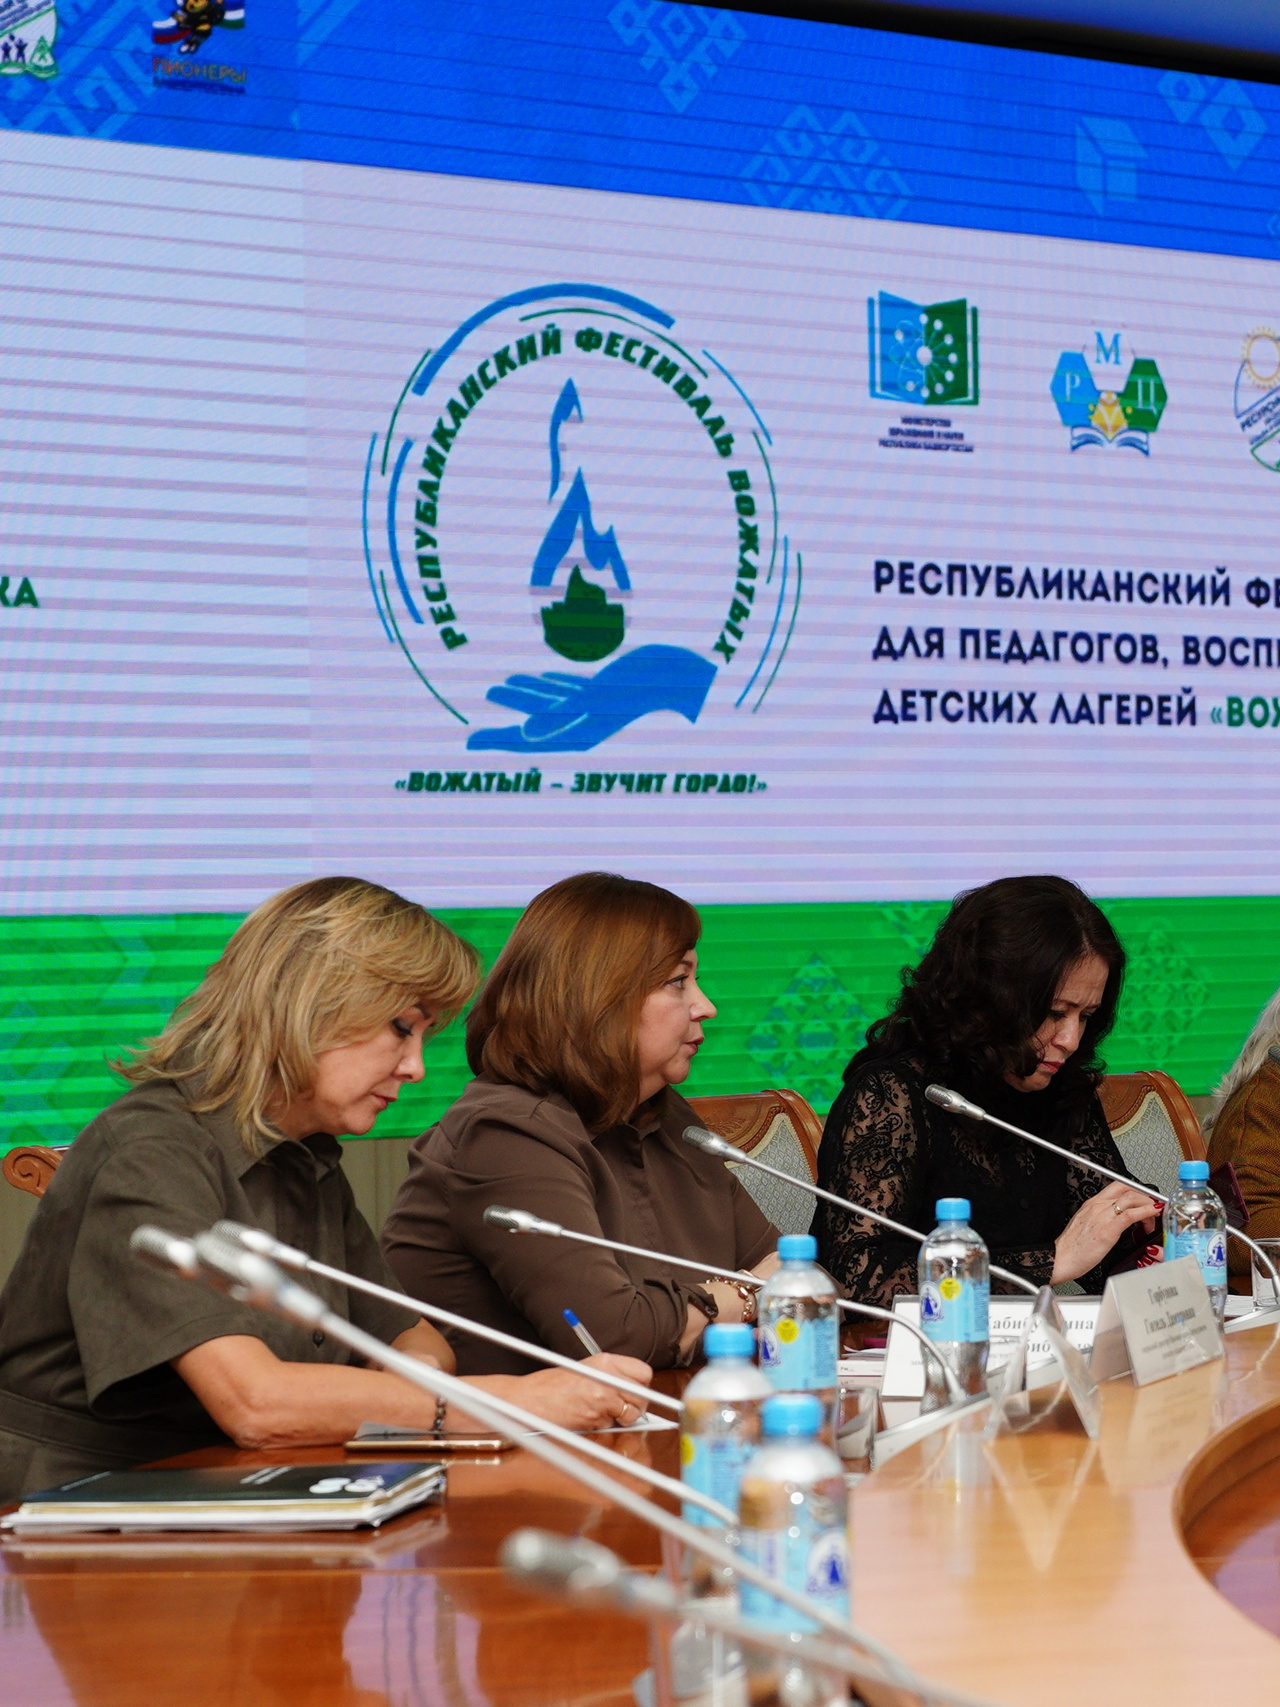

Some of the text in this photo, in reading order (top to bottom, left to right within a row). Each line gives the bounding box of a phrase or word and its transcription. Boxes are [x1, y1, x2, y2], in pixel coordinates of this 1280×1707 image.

[153, 57, 247, 84] ПИОНЕРЫ
[1094, 331, 1122, 365] М
[413, 323, 761, 664] РЕСПУБЛИКАНСКИЙ ФЕСТИВАЛЬ ВОЖАТЫХ
[873, 560, 1231, 607] РЕСПУБЛИКАНСКИЙ
[871, 625, 945, 662] ДЛЯ
[959, 627, 1169, 668] ПЕДАГОГОВ,
[872, 689, 1038, 725] ДЕТСКИХ
[1049, 687, 1197, 726] ЛАГЕРЕЙ
[394, 768, 541, 793] «ВОЖАТЫЙ
[570, 772, 667, 794] ЗВУЧИТ
[673, 772, 768, 795] ГОРДО!»
